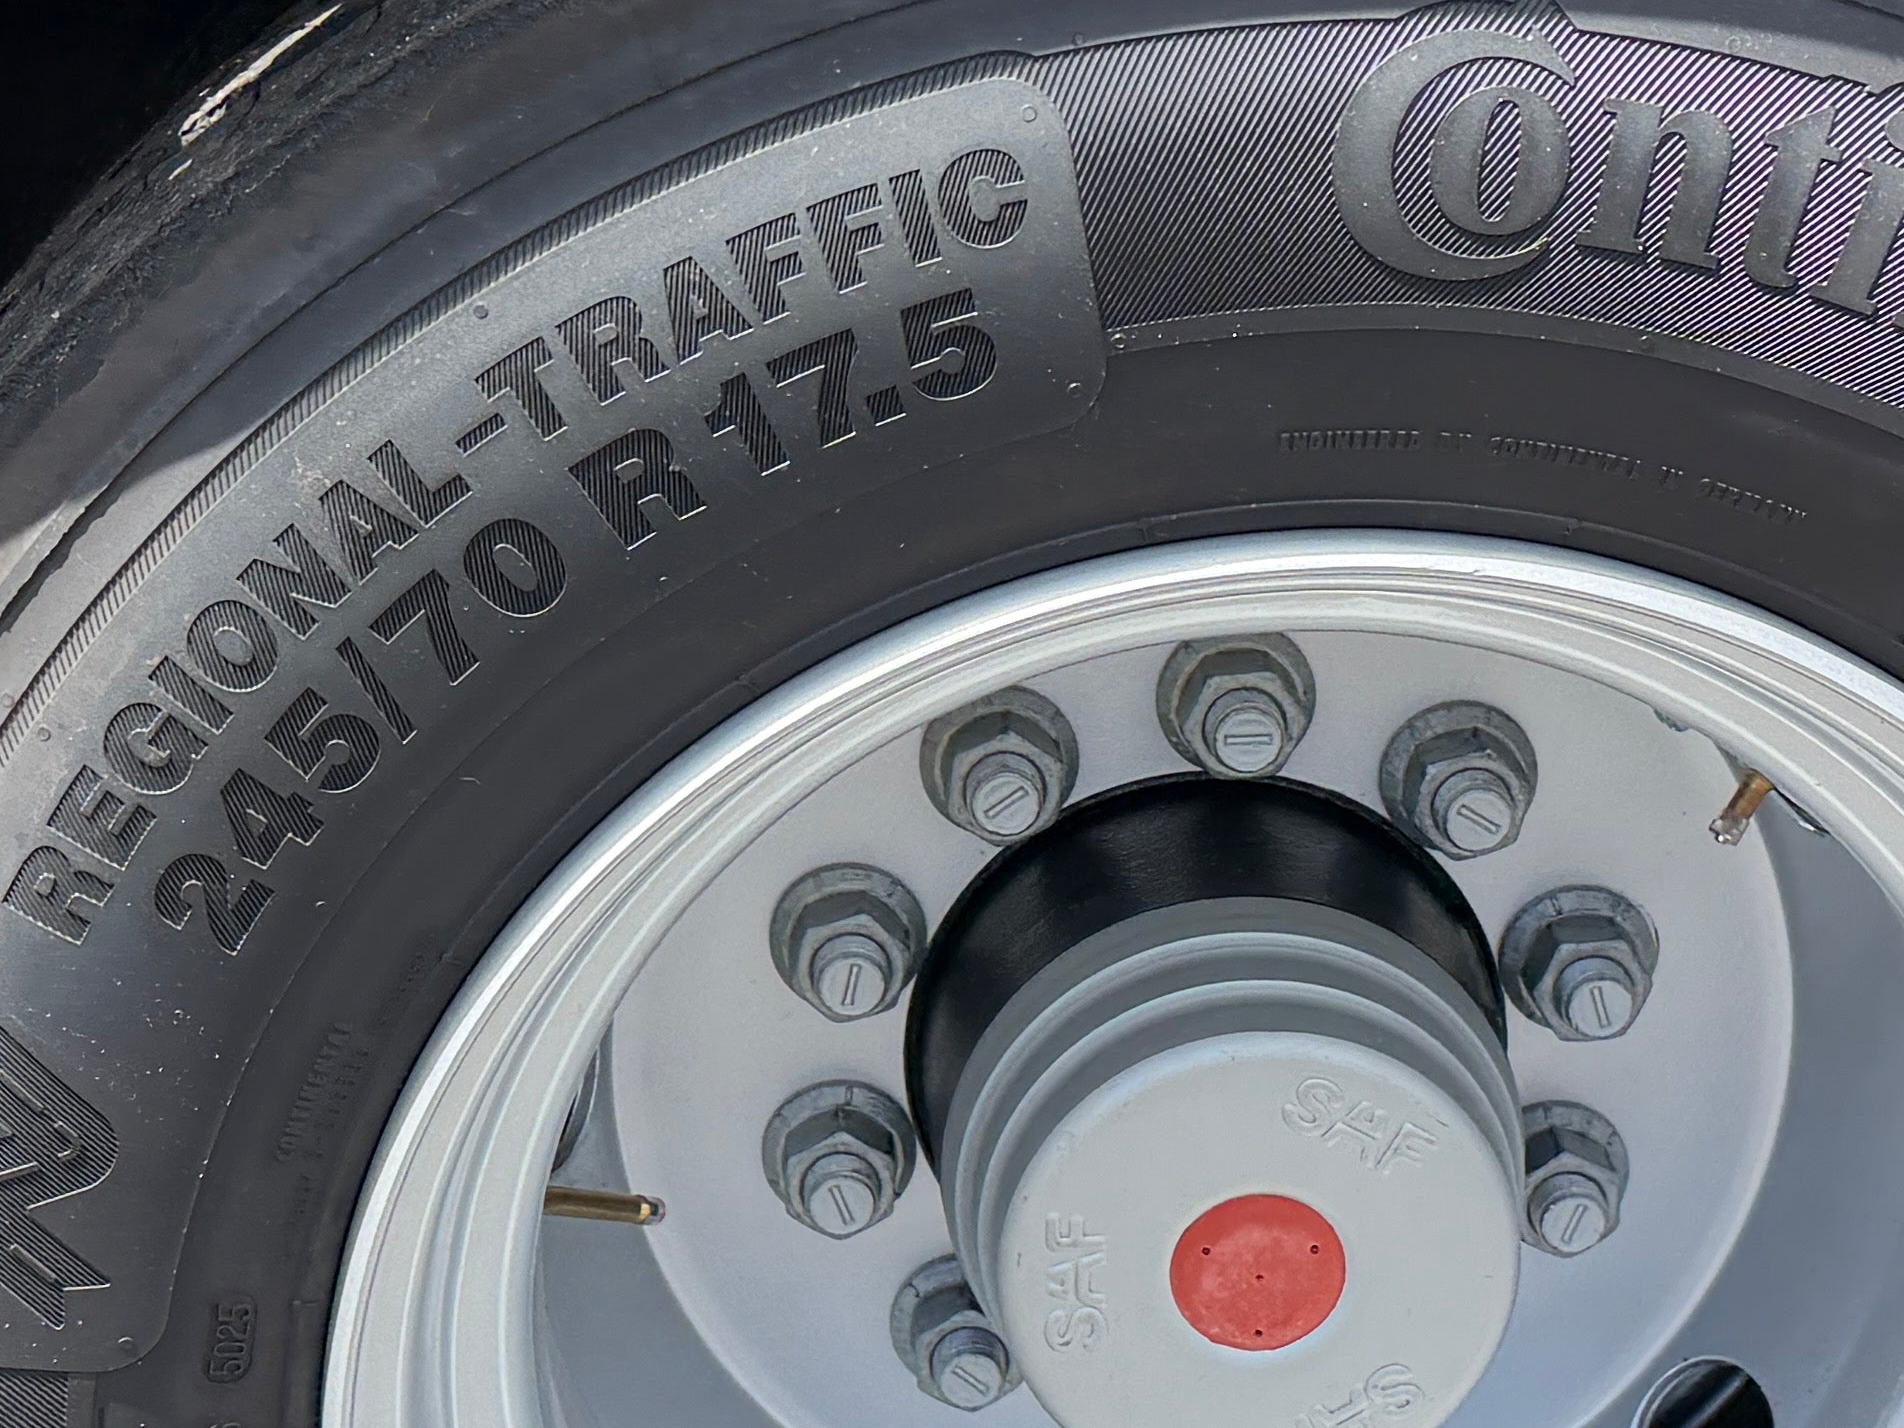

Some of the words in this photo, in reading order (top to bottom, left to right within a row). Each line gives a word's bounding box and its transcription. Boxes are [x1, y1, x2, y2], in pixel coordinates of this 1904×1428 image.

[4, 148, 1028, 944] REGIONAL-TRAFFIC
[154, 518, 569, 955] 245/70
[569, 427, 707, 550] R
[703, 288, 998, 476] 17.5
[1281, 1076, 1438, 1176] SAF
[206, 1301, 253, 1379] 5025
[1043, 1211, 1107, 1354] SAF
